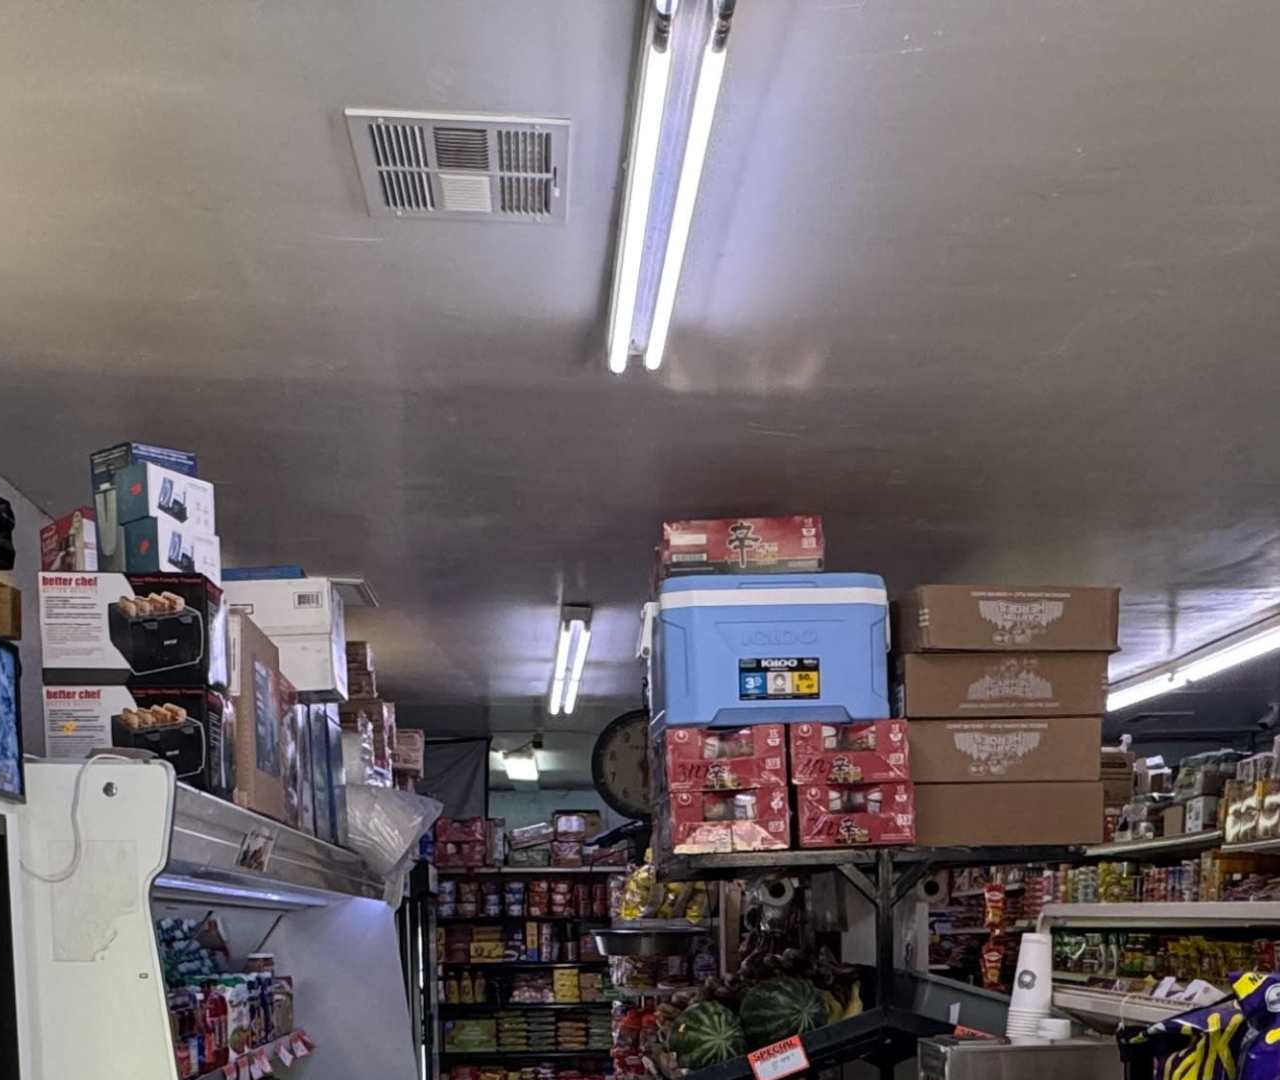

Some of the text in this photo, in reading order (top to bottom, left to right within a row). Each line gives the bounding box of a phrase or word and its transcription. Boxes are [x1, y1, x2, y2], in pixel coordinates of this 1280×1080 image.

[42, 576, 97, 586] better chef
[761, 659, 797, 667] IGLOO
[46, 690, 101, 699] better chef
